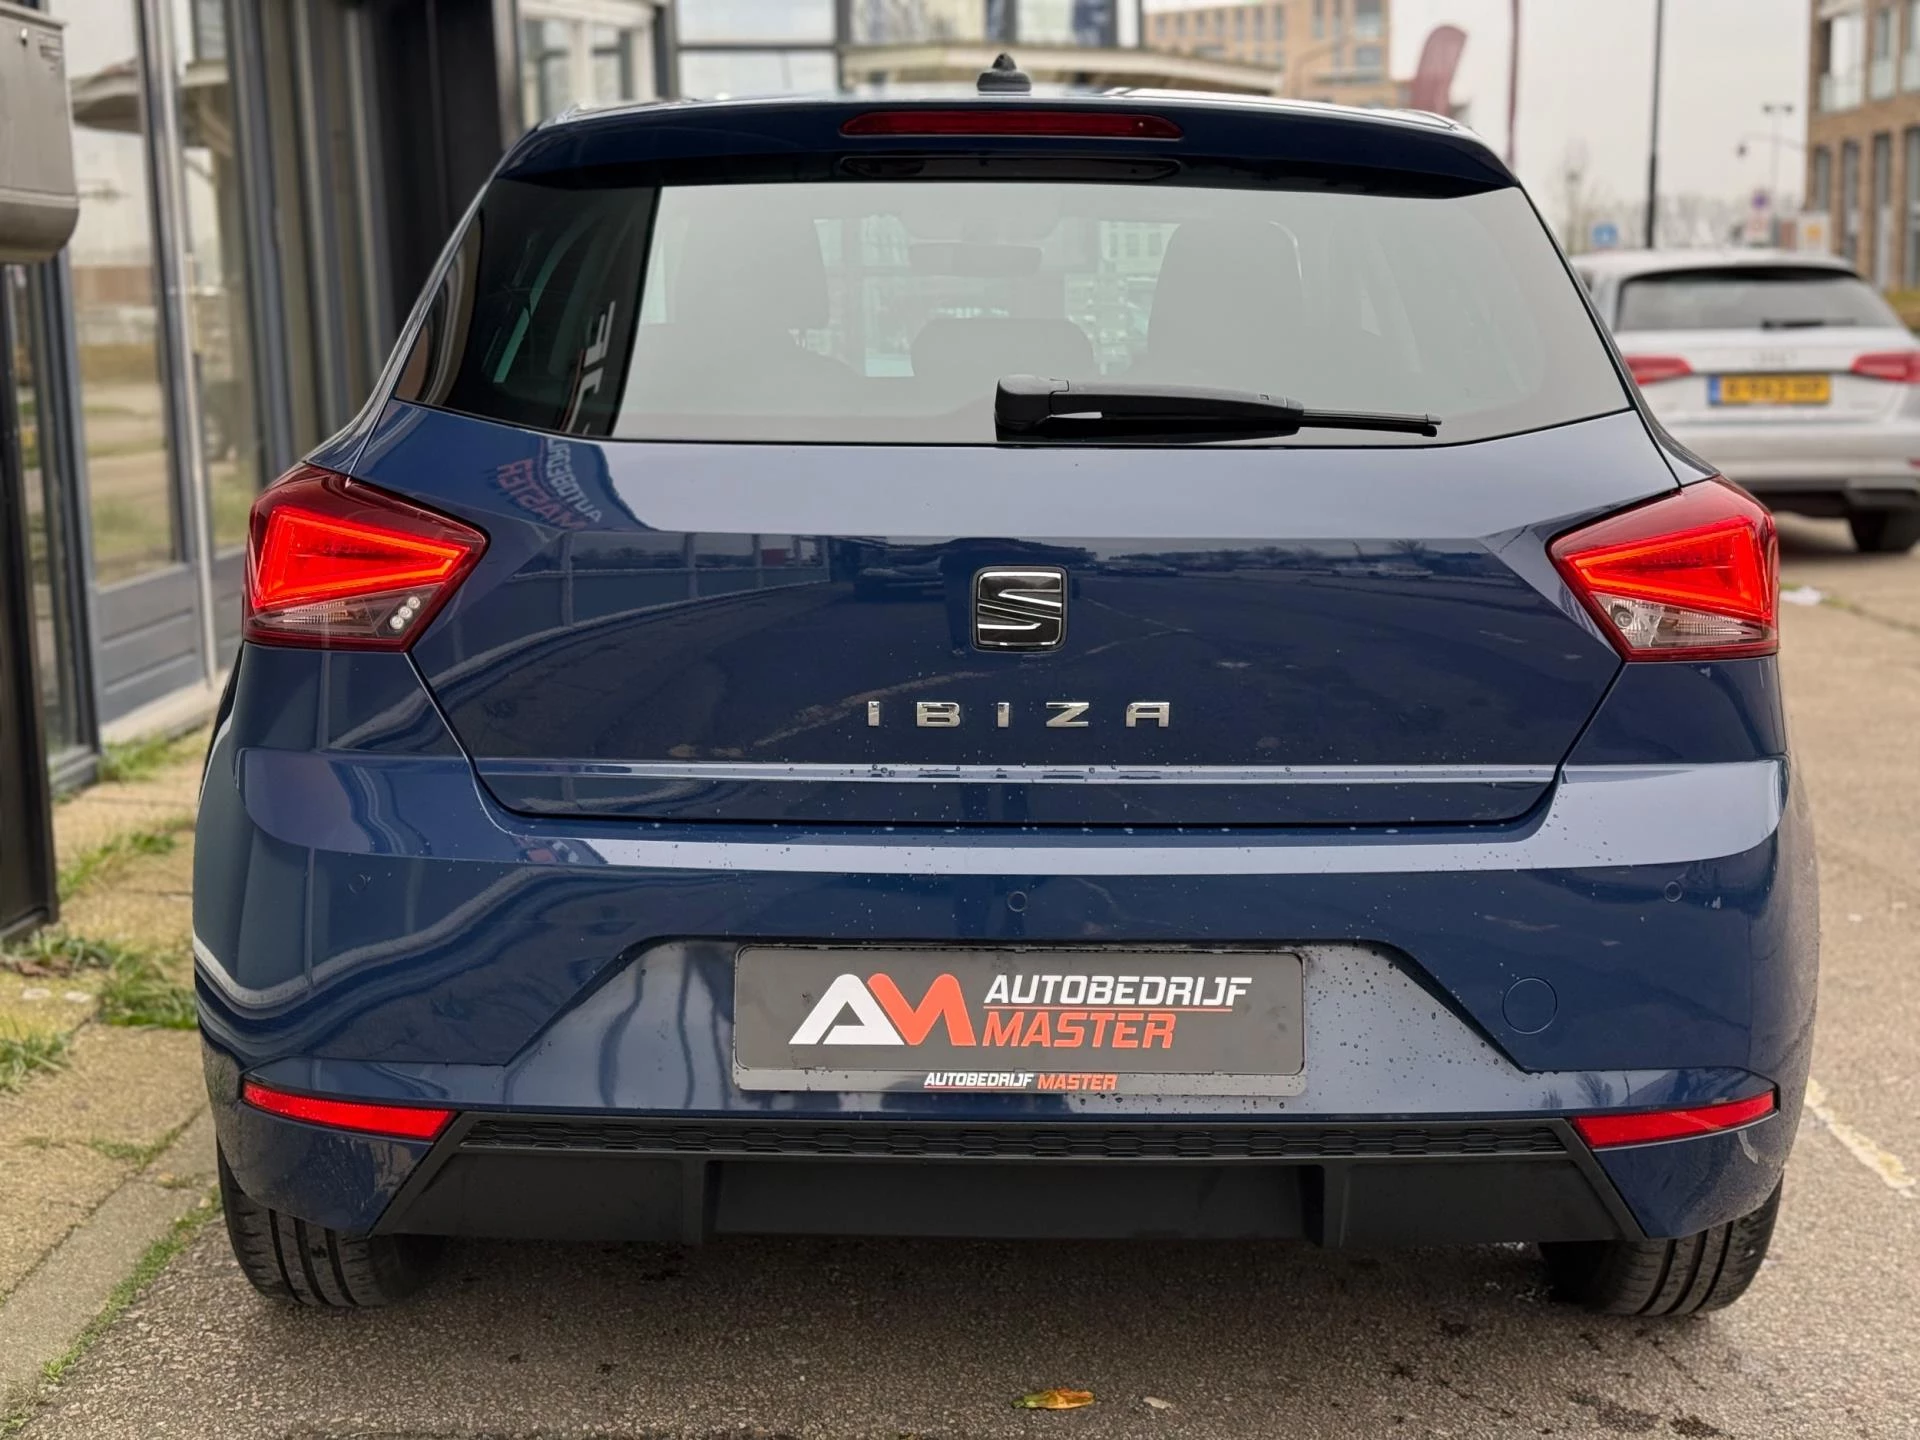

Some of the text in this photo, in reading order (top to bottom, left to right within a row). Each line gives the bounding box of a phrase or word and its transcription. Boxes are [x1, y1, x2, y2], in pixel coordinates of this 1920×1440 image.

[867, 700, 1170, 728] IBIZA
[983, 974, 1253, 1006] AUTOBEDRIJF
[982, 1012, 1176, 1050] MASTER
[923, 1072, 1118, 1091] AUTOBEDRIJF MASTER
